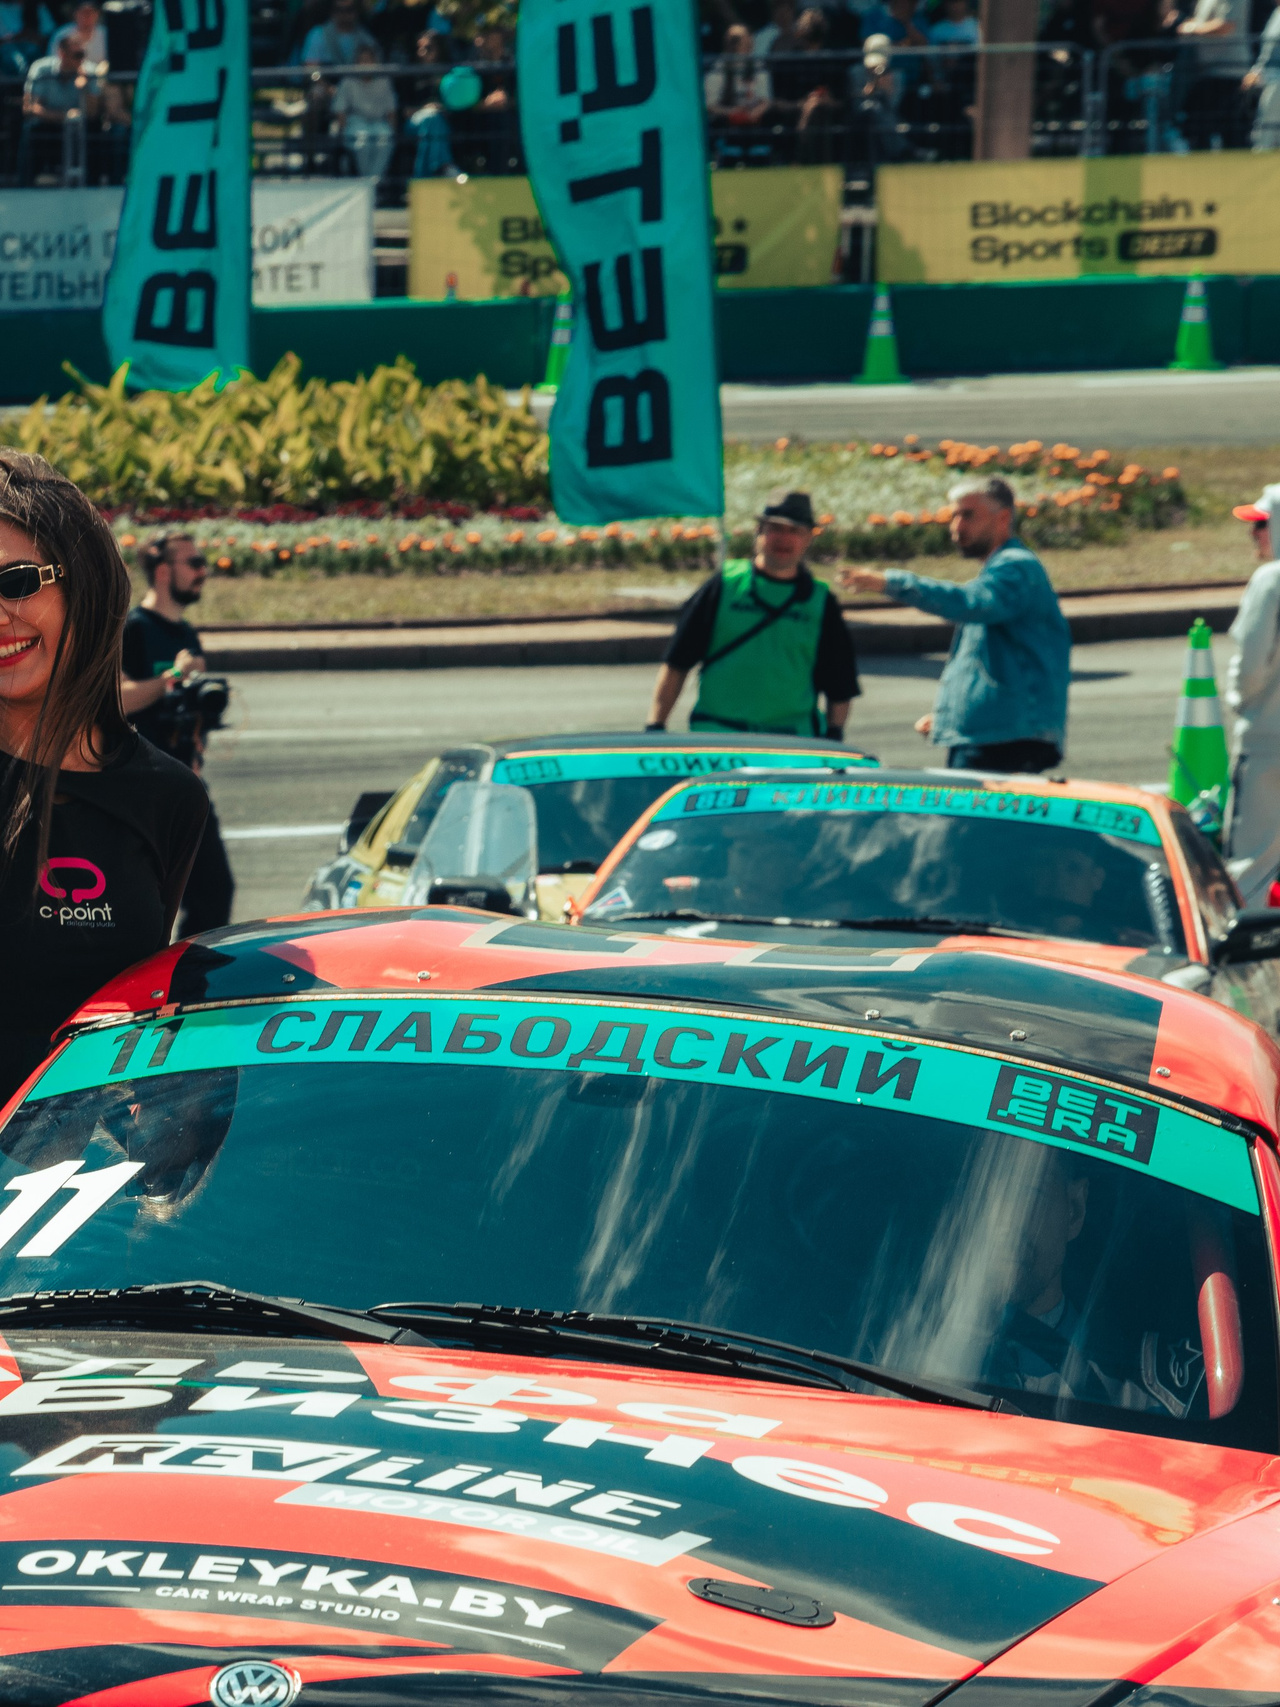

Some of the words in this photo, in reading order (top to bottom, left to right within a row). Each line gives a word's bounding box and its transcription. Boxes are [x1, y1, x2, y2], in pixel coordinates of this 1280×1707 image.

[972, 196, 1192, 228] Blockchain
[972, 234, 1108, 267] Sports
[107, 1017, 185, 1076] 11
[255, 1009, 923, 1102] СЛАБОДСКИЙ
[1011, 1074, 1143, 1126] BET
[315, 1490, 539, 1531] MOTOR
[549, 1524, 640, 1556] OIL
[16, 1549, 574, 1630] OKLEYKA.BY
[154, 1586, 210, 1600] CAR
[216, 1590, 294, 1607] WRAP
[299, 1598, 401, 1622] STUDIO
